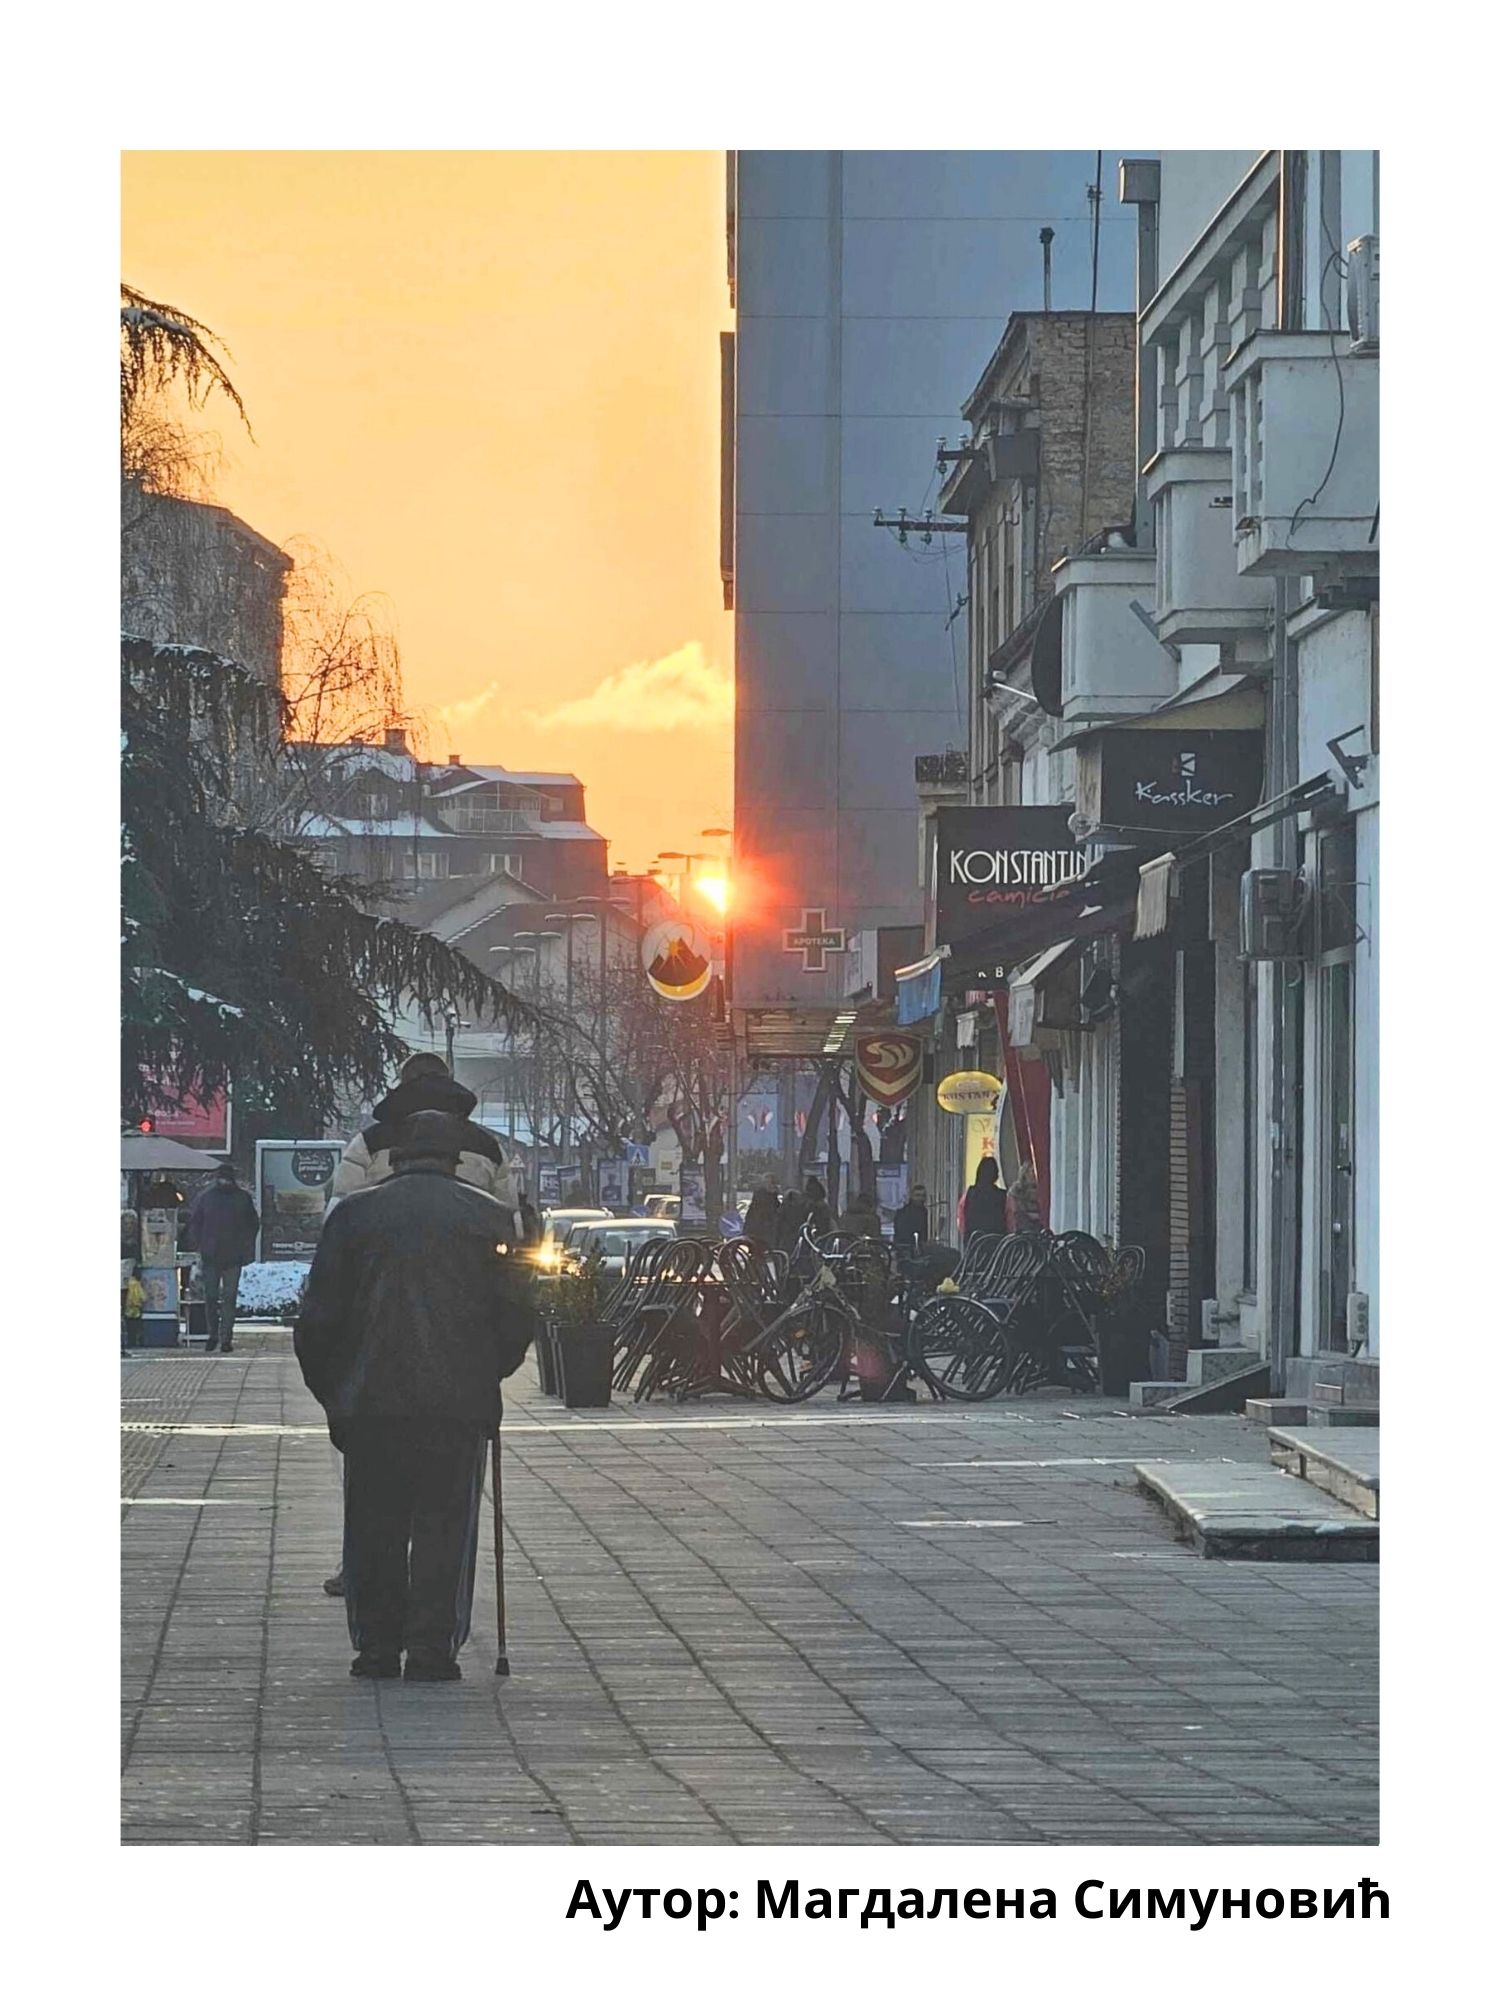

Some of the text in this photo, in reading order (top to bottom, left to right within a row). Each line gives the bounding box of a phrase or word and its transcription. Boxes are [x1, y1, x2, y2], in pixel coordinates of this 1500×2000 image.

[1136, 780, 1233, 805] Kassker
[950, 850, 1086, 884] KONSTANTIN
[793, 937, 836, 946] APOTEKA
